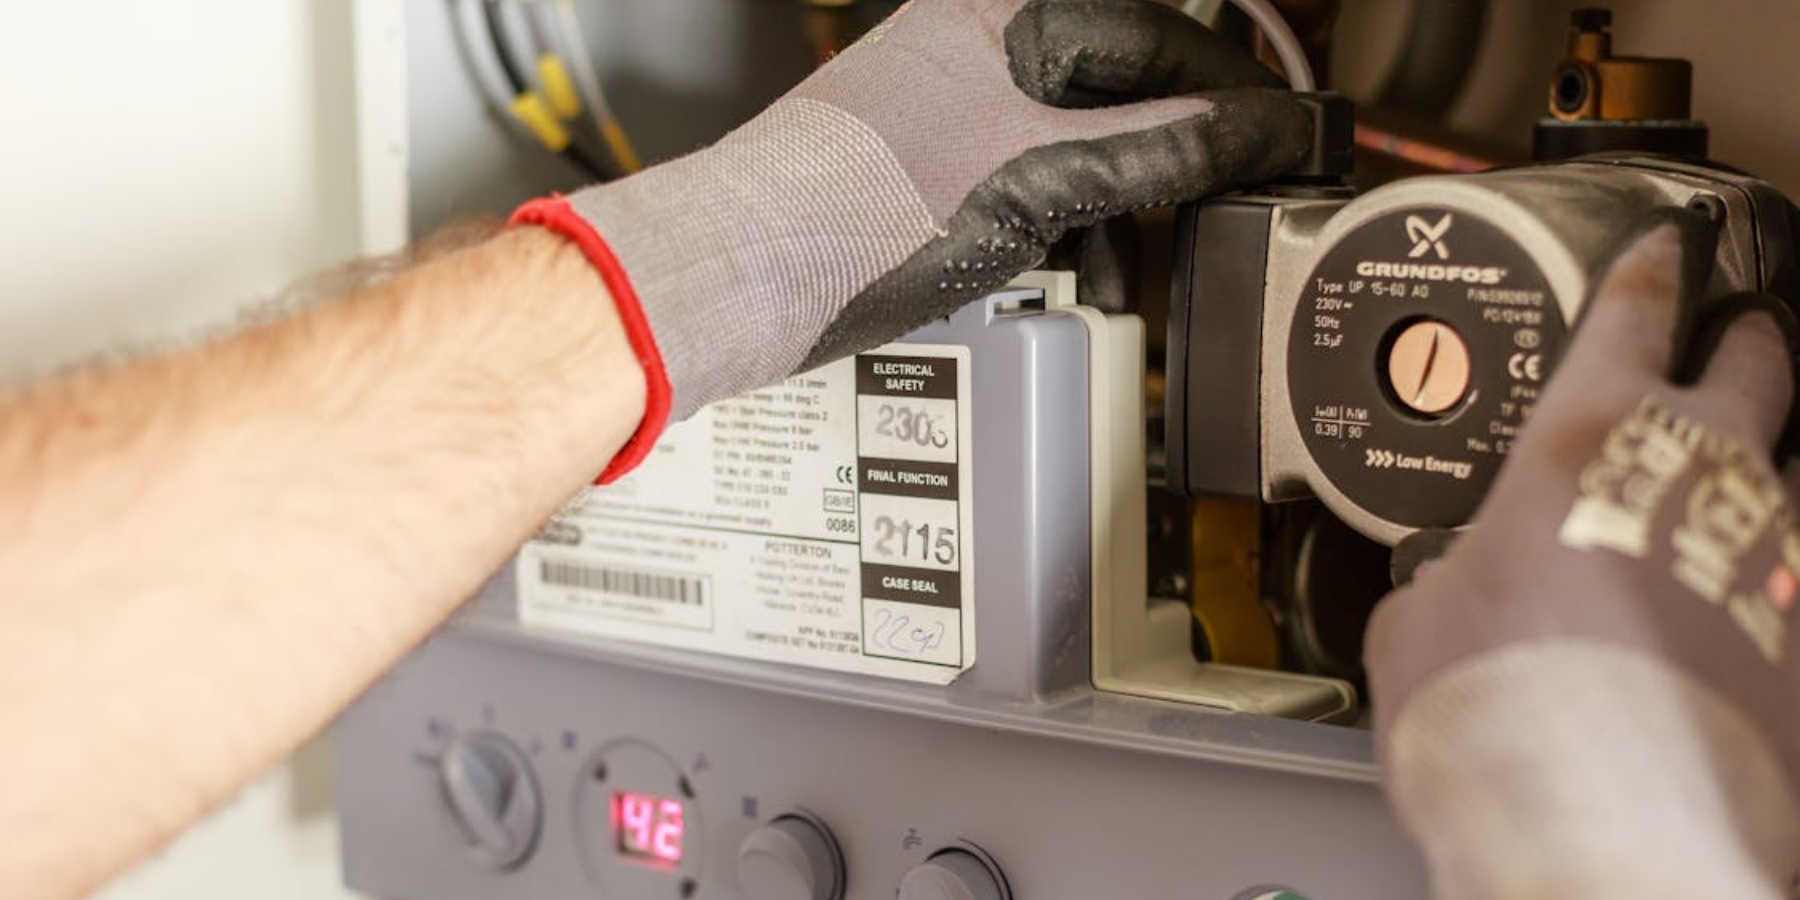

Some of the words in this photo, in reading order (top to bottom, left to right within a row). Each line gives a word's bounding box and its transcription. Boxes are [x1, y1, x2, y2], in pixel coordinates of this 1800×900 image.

[1356, 261, 1500, 284] GRUNDFOS
[1316, 278, 1343, 294] Type
[1348, 280, 1364, 293] UP
[1371, 281, 1406, 297] 15-60
[1314, 315, 1340, 328] 50Hz
[873, 362, 935, 377] ELECTRICAL
[885, 378, 926, 391] SAFETY
[1315, 423, 1338, 437] 0.39
[1348, 426, 1362, 439] 90
[1396, 454, 1423, 469] Low
[1425, 457, 1472, 479] Energy
[867, 469, 896, 482] FINAL
[897, 471, 948, 487] FUNCTION
[826, 517, 856, 533] 0086
[882, 576, 909, 590] CASE
[911, 580, 938, 593] SEAL
[622, 792, 683, 860] 42
